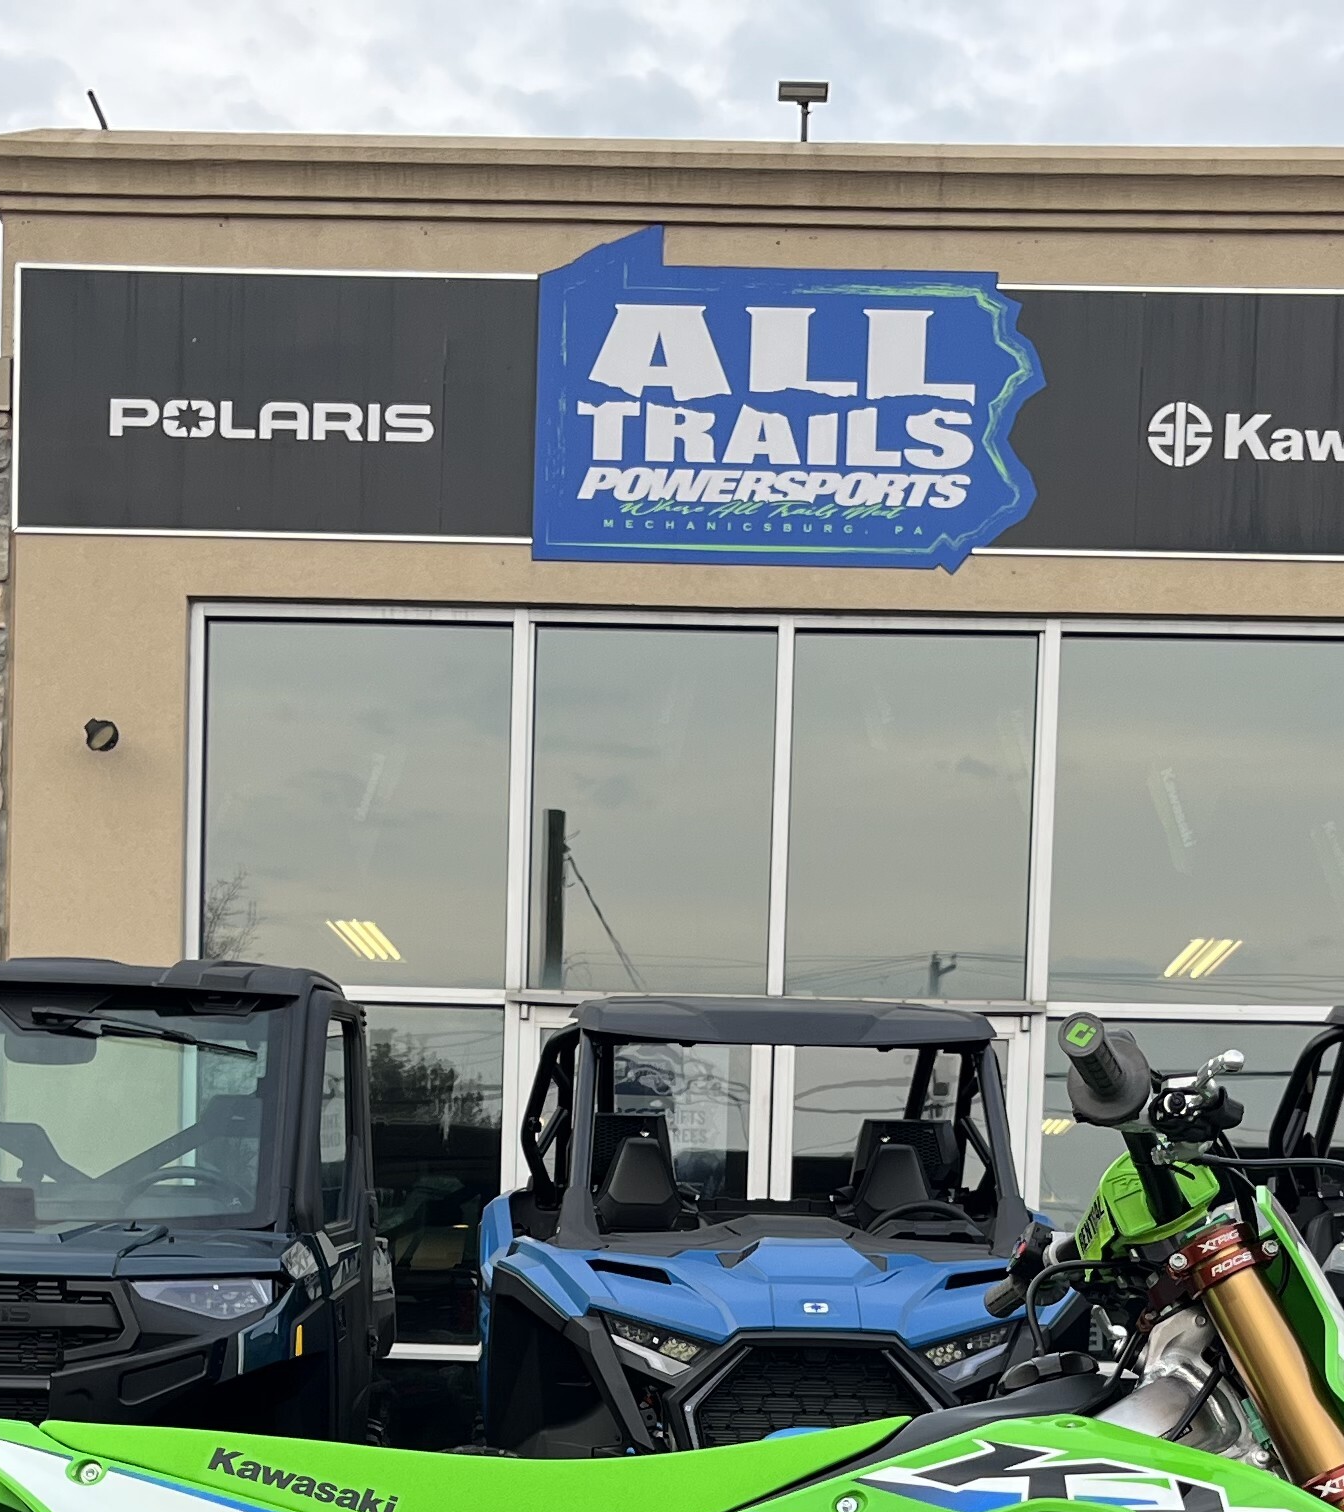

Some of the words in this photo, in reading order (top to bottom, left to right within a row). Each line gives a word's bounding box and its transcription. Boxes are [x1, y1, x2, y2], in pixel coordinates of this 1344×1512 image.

[589, 303, 975, 406] ALL
[109, 398, 434, 442] POLARIS
[577, 401, 974, 470] TRAILS
[577, 467, 971, 508] POWERSPORTS
[620, 499, 704, 517] Where
[708, 500, 757, 517] All
[768, 501, 838, 520] Trails
[895, 525, 923, 535] PA
[1197, 1229, 1240, 1253] XTRIG
[1211, 1251, 1253, 1277] ROCS
